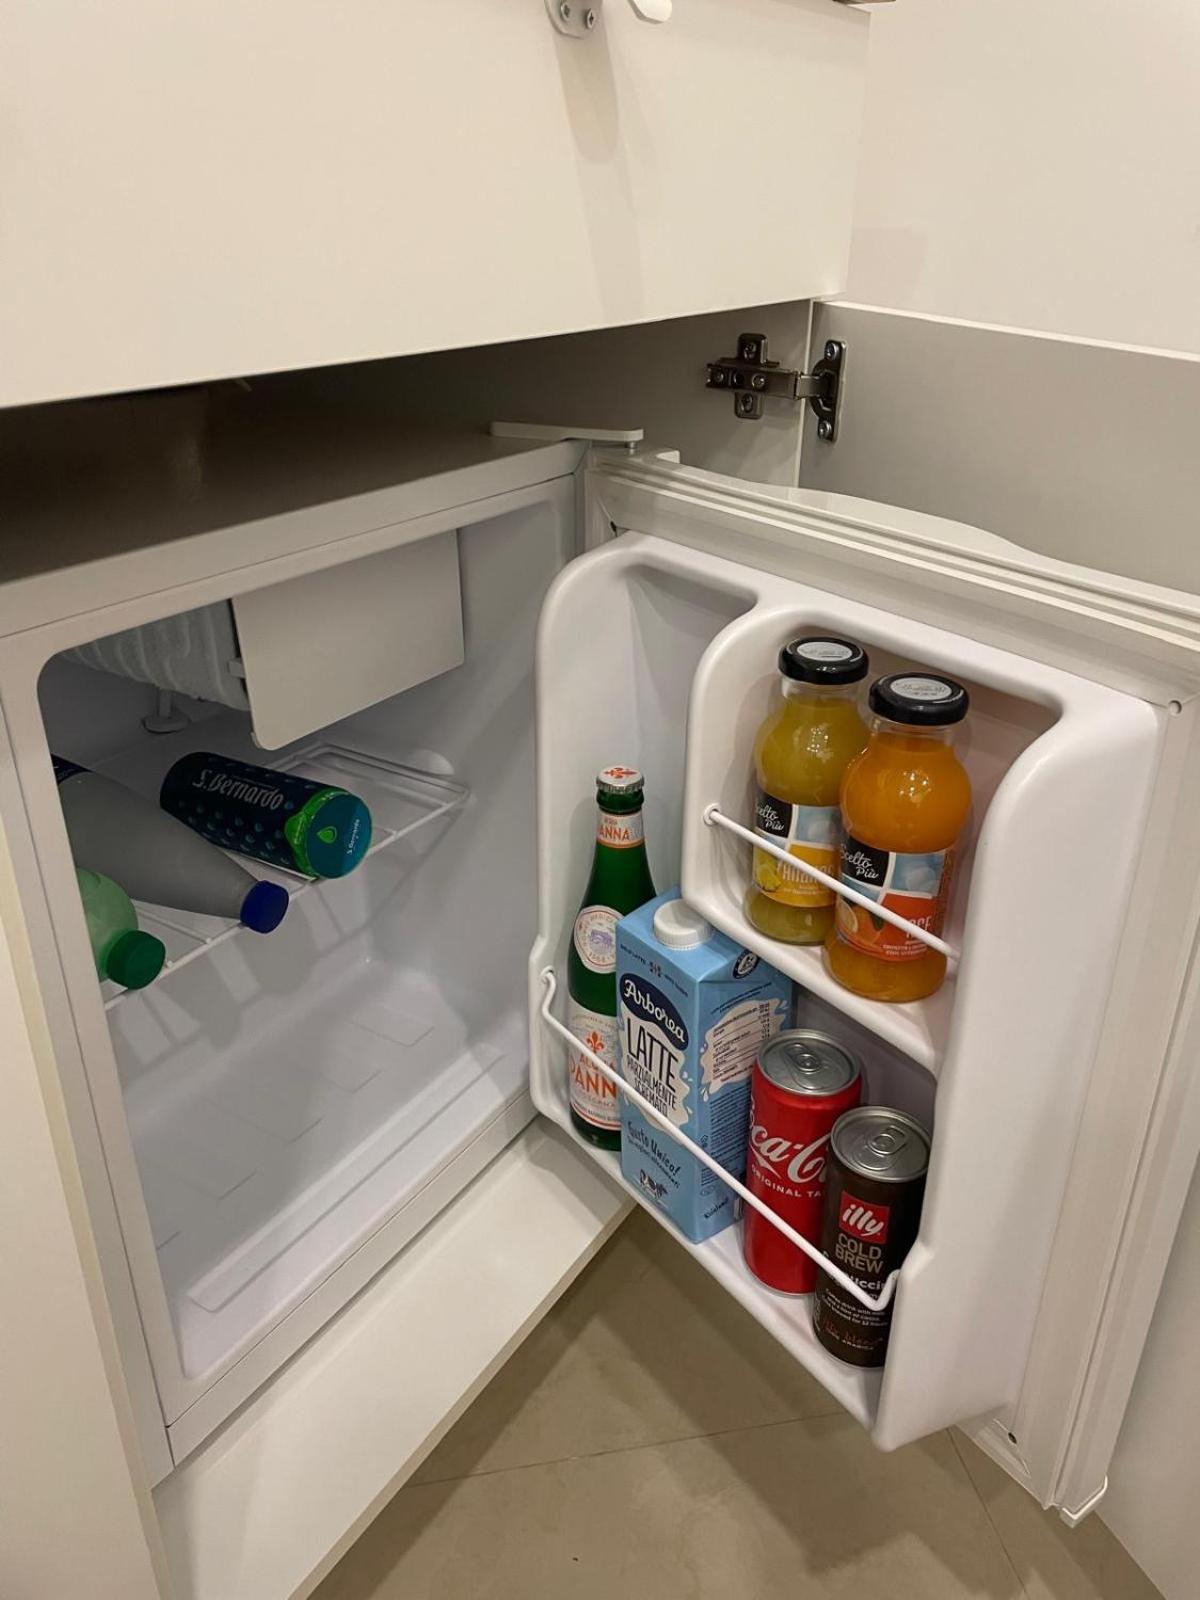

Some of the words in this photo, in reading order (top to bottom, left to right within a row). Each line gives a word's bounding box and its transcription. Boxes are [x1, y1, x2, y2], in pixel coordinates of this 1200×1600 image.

[623, 979, 686, 1043] Arborea
[627, 1016, 679, 1093] LATTE
[842, 1203, 885, 1237] illy
[835, 1243, 885, 1274] BREW
[838, 1232, 883, 1260] COLD
